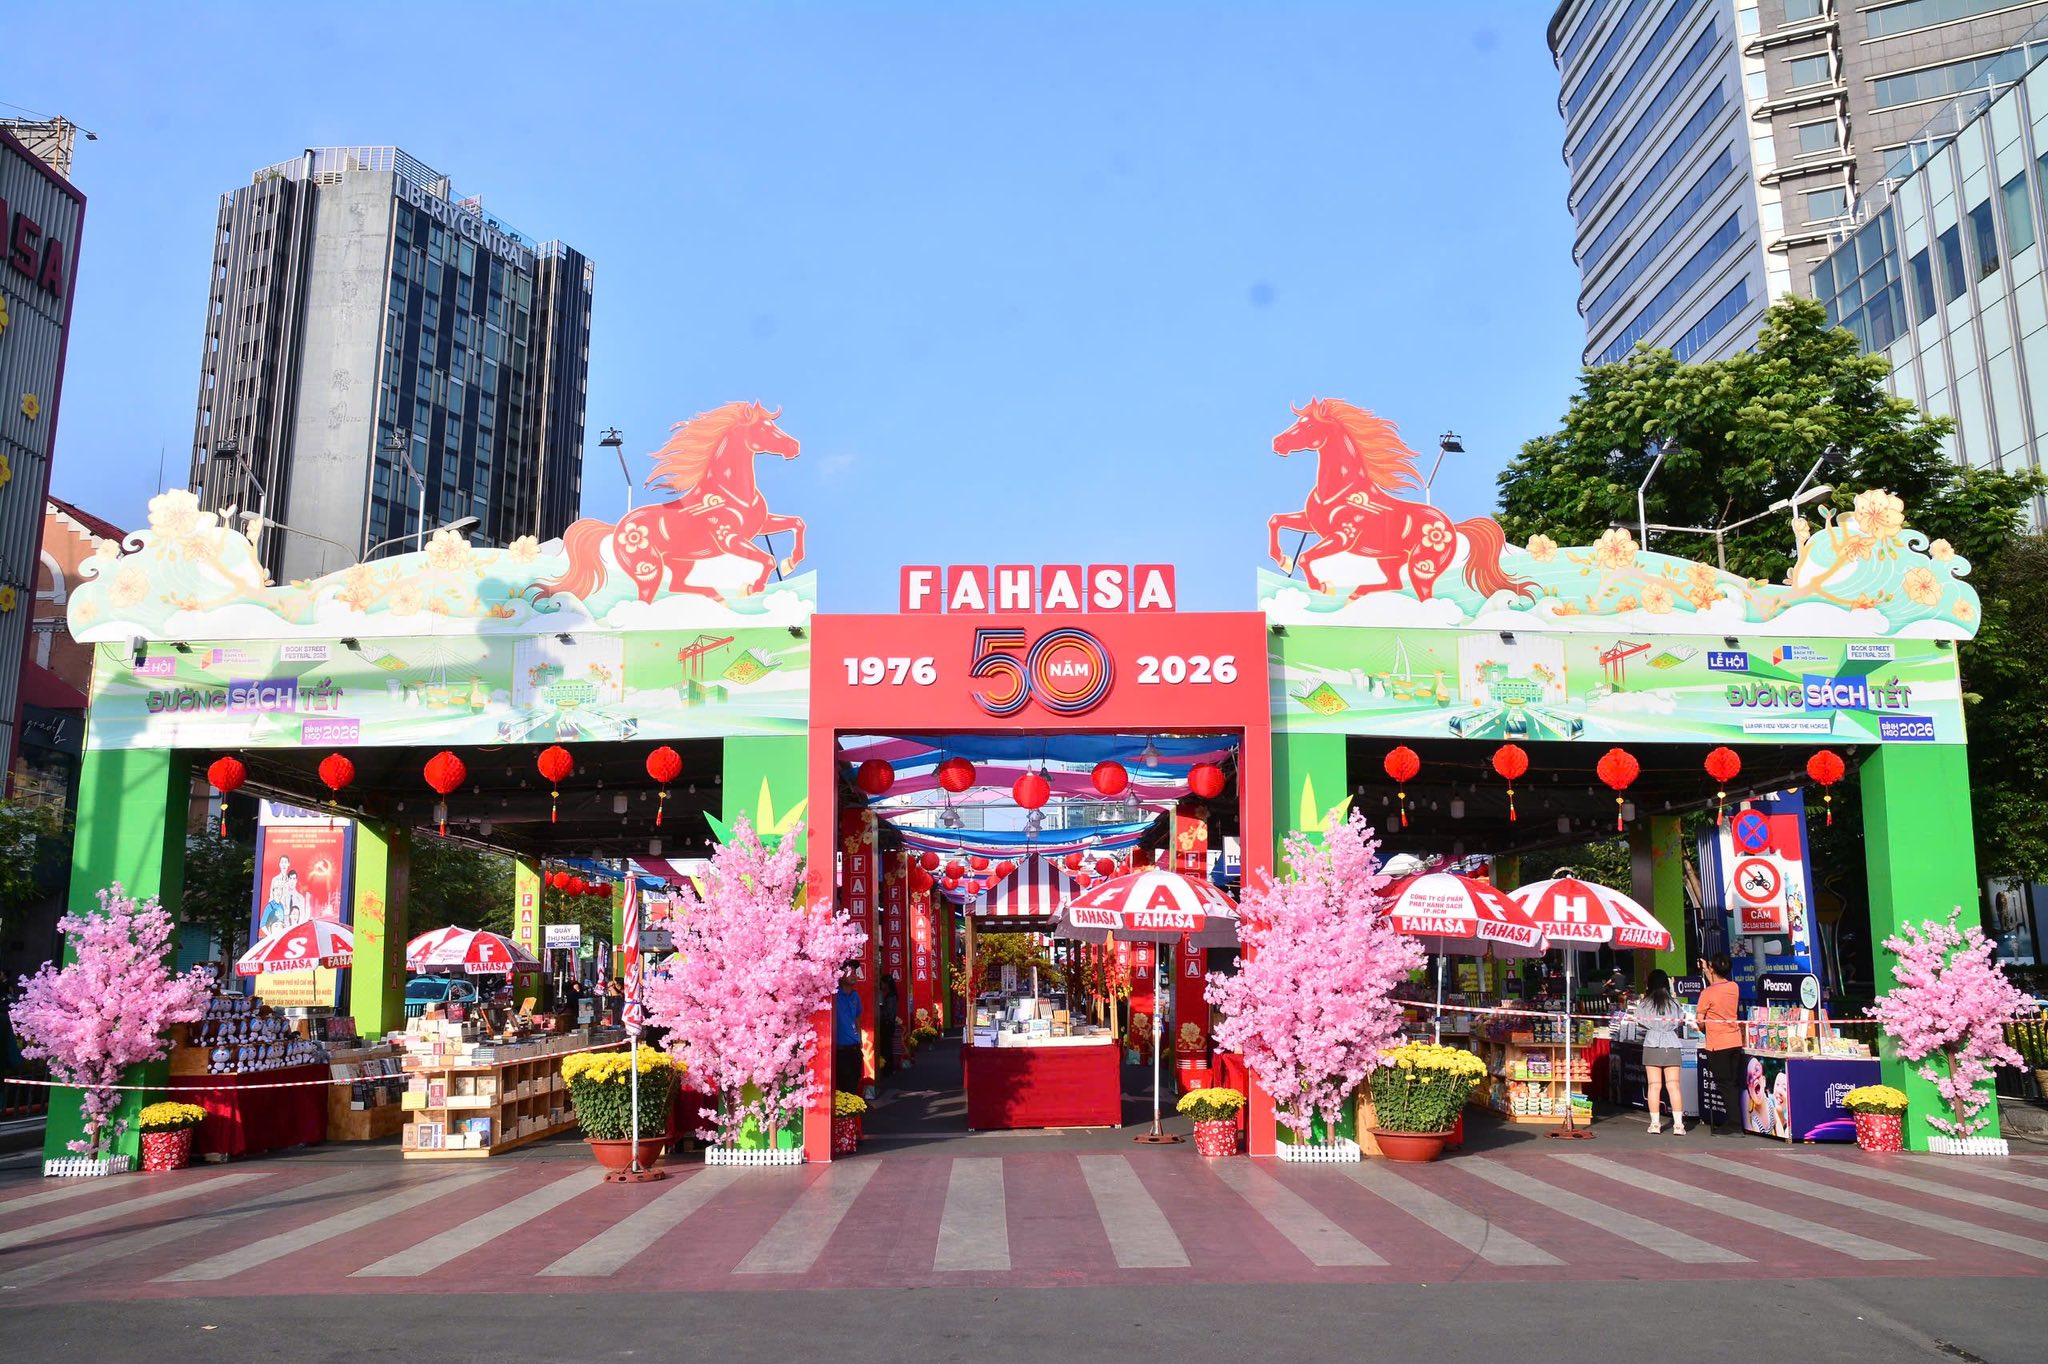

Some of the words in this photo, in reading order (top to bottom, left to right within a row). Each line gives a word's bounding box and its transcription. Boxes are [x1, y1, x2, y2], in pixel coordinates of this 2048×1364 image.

[396, 174, 461, 230] LIBERTY
[460, 214, 527, 272] CENTRAL
[908, 570, 1173, 610] FAHASA
[152, 660, 171, 674] HỘI
[844, 656, 938, 686] 1976
[1049, 662, 1089, 678] NĂM
[1136, 654, 1239, 684] 2026
[968, 626, 1115, 717] 50
[1710, 653, 1724, 667] LỄ
[1726, 656, 1744, 669] HỘI
[145, 684, 228, 713] ĐƯỜNG
[231, 680, 292, 709] SÁCH
[300, 676, 343, 711] TẾT
[1725, 680, 1803, 708] ĐƯỜNG
[1806, 679, 1866, 707] SÁCH
[1870, 676, 1912, 708] TẾT
[322, 727, 358, 741] 2026
[1899, 723, 1933, 737] 2026
[1227, 855, 1241, 863] TH
[1075, 910, 1117, 926] FAHASA
[1134, 912, 1195, 929] FAHASA
[1750, 906, 1771, 919] CẤM
[522, 894, 532, 987] FAHAA
[891, 888, 901, 980] FAHASA
[917, 904, 926, 980] FAHASA
[1401, 916, 1467, 934] FAHASA
[1482, 922, 1532, 944] FAHASA
[1542, 923, 1603, 939] FAHASA
[1619, 928, 1664, 946] FAHASA
[270, 960, 312, 972] FAHASA
[328, 956, 353, 967] FAHA
[471, 962, 508, 972] FAHASA
[1766, 979, 1792, 992] Pearson
